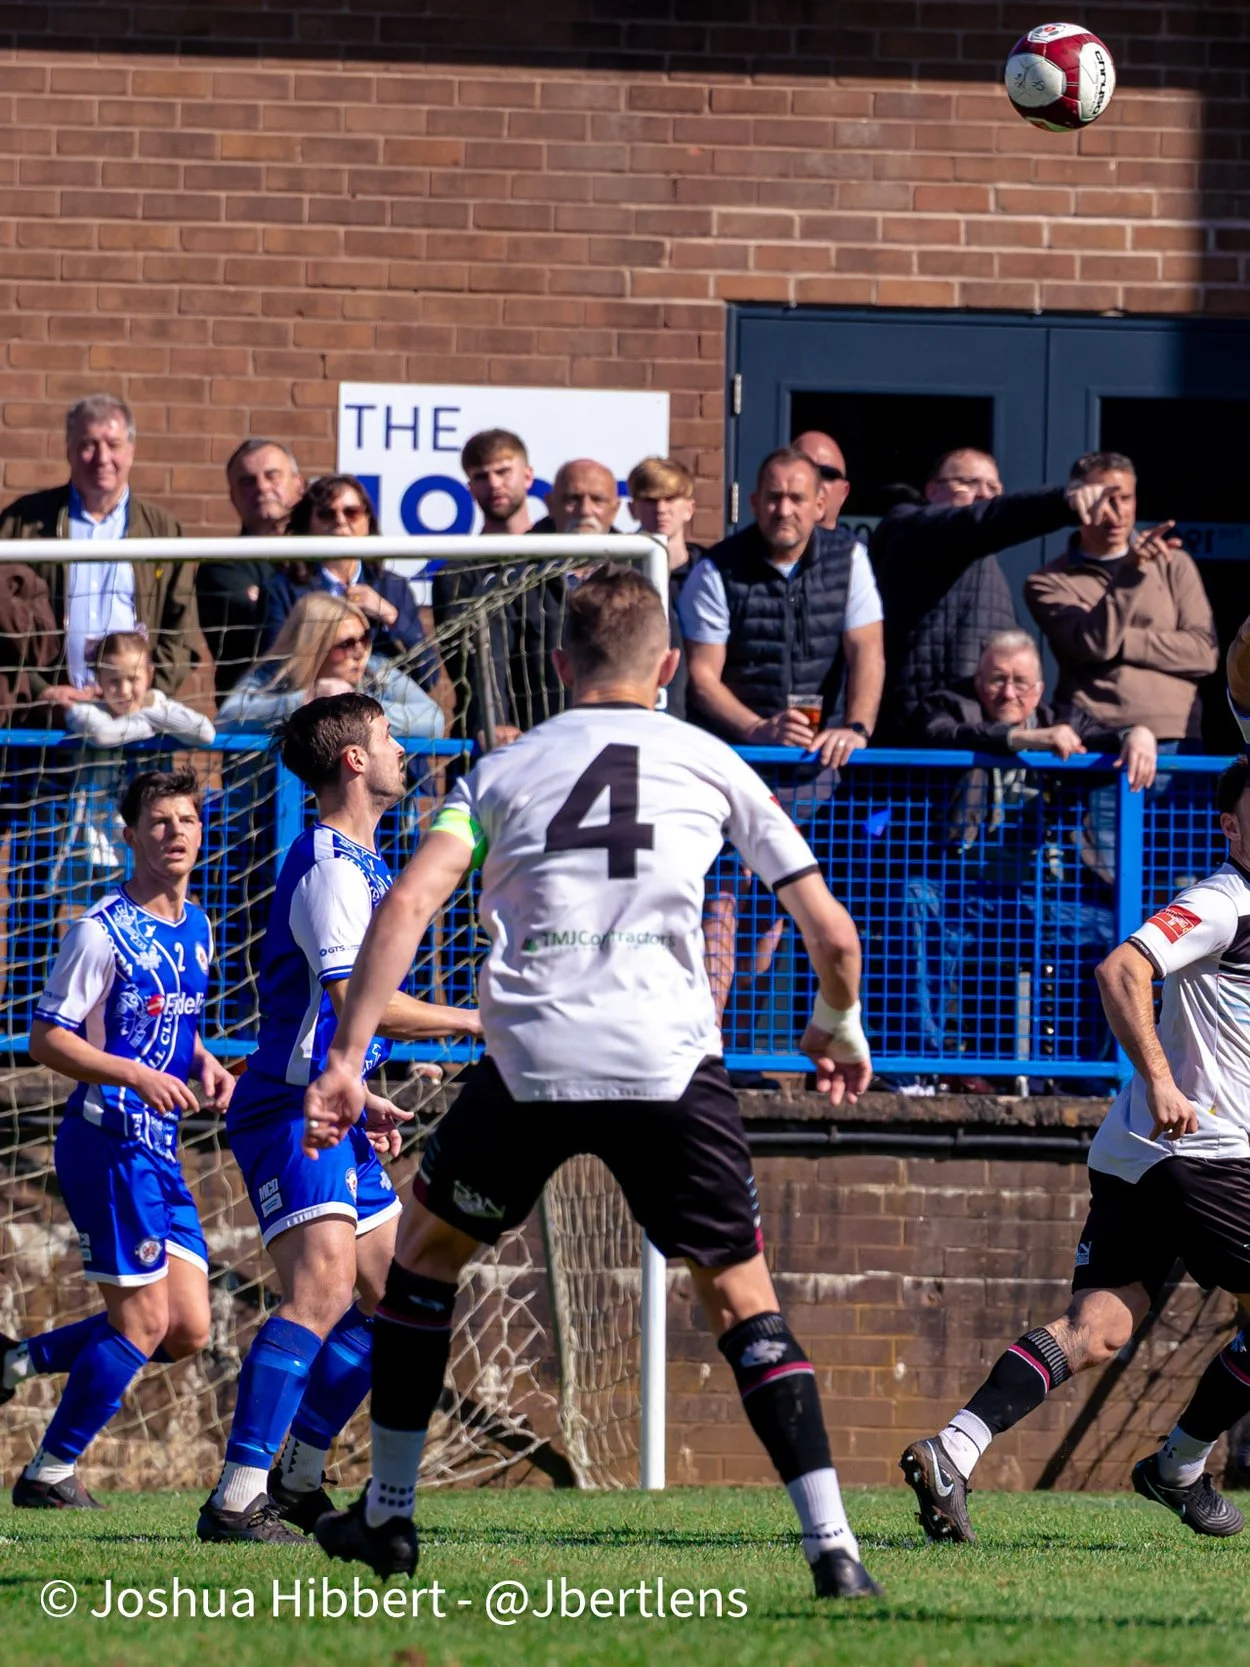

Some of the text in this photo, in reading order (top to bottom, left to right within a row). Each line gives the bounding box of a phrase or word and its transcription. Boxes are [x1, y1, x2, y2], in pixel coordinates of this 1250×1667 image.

[345, 404, 461, 451] THE
[545, 742, 655, 880] 4
[173, 941, 186, 972] 2
[327, 945, 346, 954] GTS
